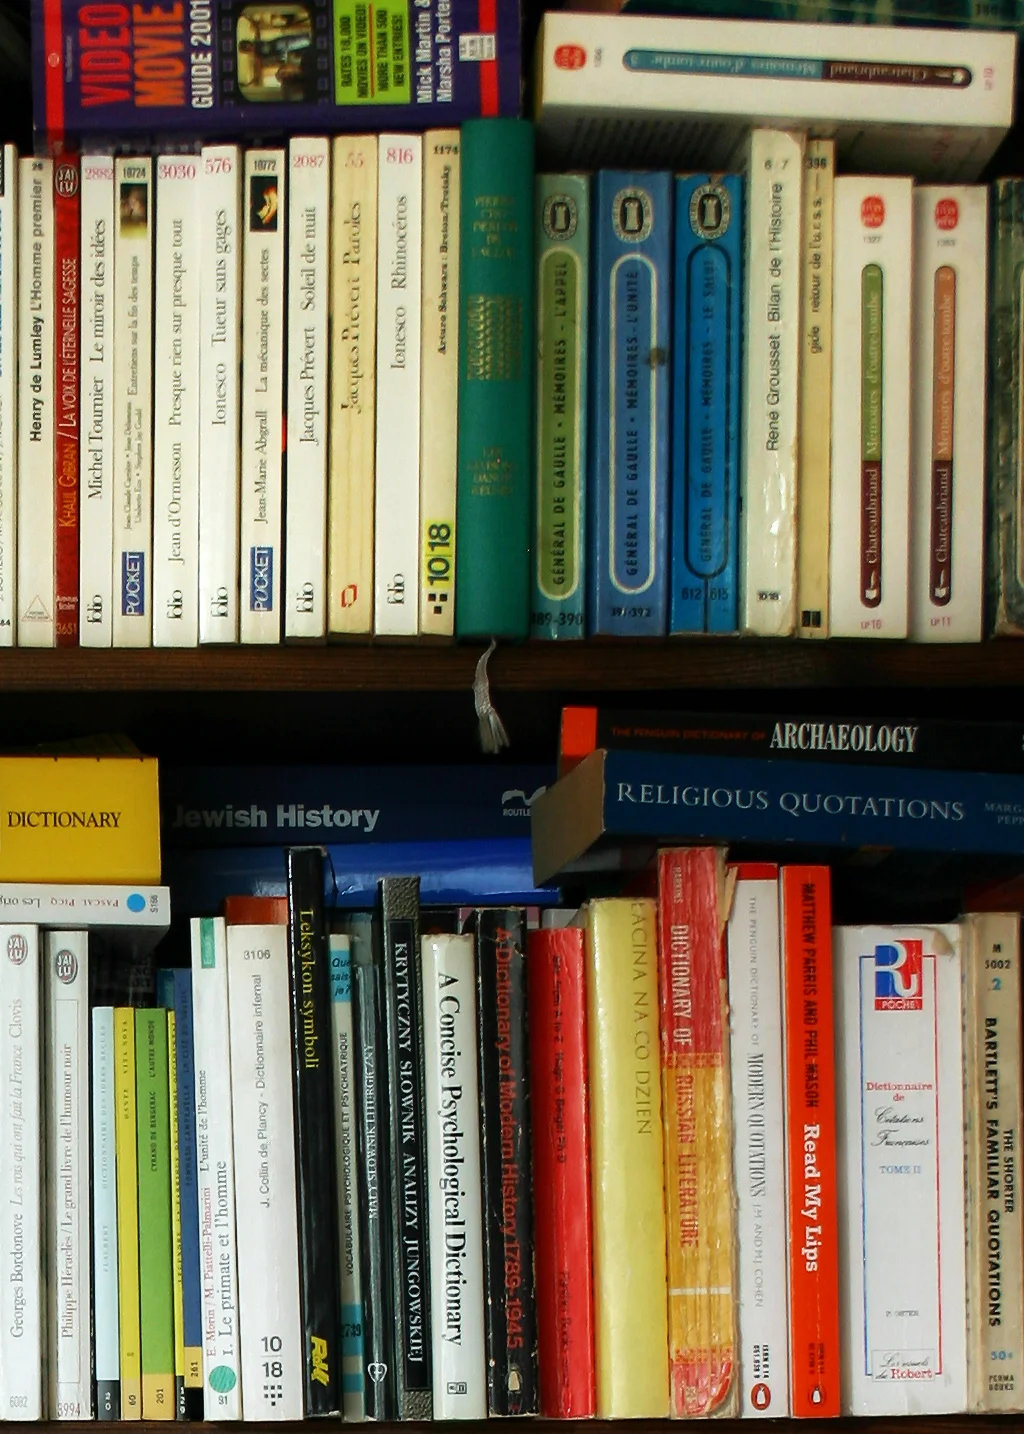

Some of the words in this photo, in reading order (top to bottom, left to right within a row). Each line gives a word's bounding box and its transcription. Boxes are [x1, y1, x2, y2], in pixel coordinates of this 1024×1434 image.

[191, 0, 212, 48] 2001
[78, 5, 131, 107] VIDEO
[133, 2, 184, 107] MOVIE
[191, 53, 213, 109] GUIDE
[30, 179, 46, 236] premier
[766, 183, 784, 251] l'Histoire
[29, 242, 44, 311] L'Homme
[766, 257, 782, 277] de
[765, 284, 783, 321] Bilan
[29, 316, 46, 369] Lumley
[29, 375, 43, 393] de
[765, 334, 782, 405] Grousset
[29, 398, 46, 442] Henry
[764, 411, 781, 451] René
[770, 723, 918, 754] ARCHAEOLOGY
[7, 811, 121, 828] DICTIONARY
[174, 803, 267, 828] Jewish
[276, 802, 380, 831] History
[616, 782, 770, 814] RELIGIOUS
[778, 789, 964, 821] QUOTATIONS
[439, 971, 462, 989] A
[439, 995, 460, 1078] Concise
[439, 1086, 464, 1226] Psychological
[803, 1124, 820, 1169] Read
[805, 1185, 823, 1220] My
[805, 1226, 823, 1271] Lips
[441, 1231, 467, 1346] Dictionary
